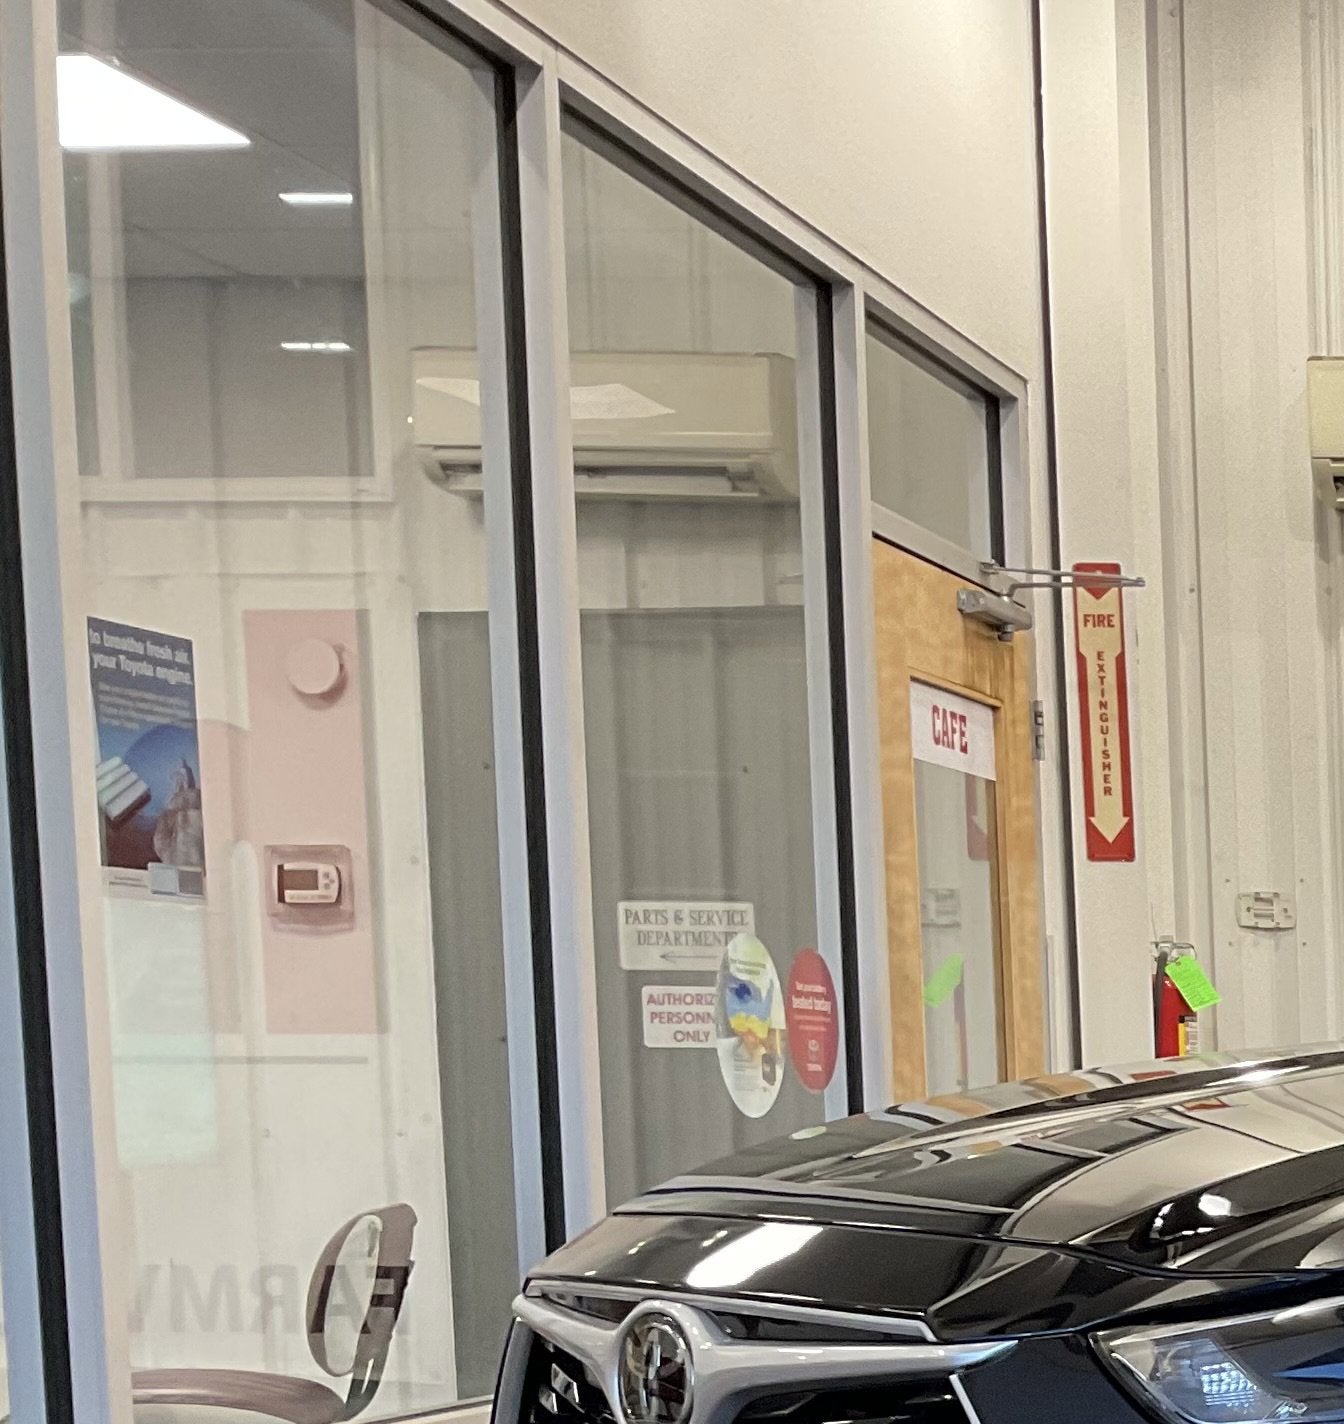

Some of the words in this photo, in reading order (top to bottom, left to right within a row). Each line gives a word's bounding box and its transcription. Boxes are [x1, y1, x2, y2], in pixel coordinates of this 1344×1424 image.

[1083, 613, 1115, 628] FIRE
[89, 628, 100, 645] to
[103, 631, 144, 655] breathe
[146, 641, 172, 661] fresh
[93, 654, 117, 669] your
[118, 654, 154, 677] Toyota
[932, 704, 968, 755] CAFE
[1097, 651, 1112, 796] EXTINGUISHER
[624, 909, 668, 926] PARTS
[674, 911, 684, 925] &
[689, 910, 749, 926] SERVICE
[637, 930, 738, 946] DEPARTMENT
[647, 993, 717, 1006] AUTHORIZ
[651, 1011, 715, 1024] PERSONN
[673, 1030, 711, 1043] ONLY
